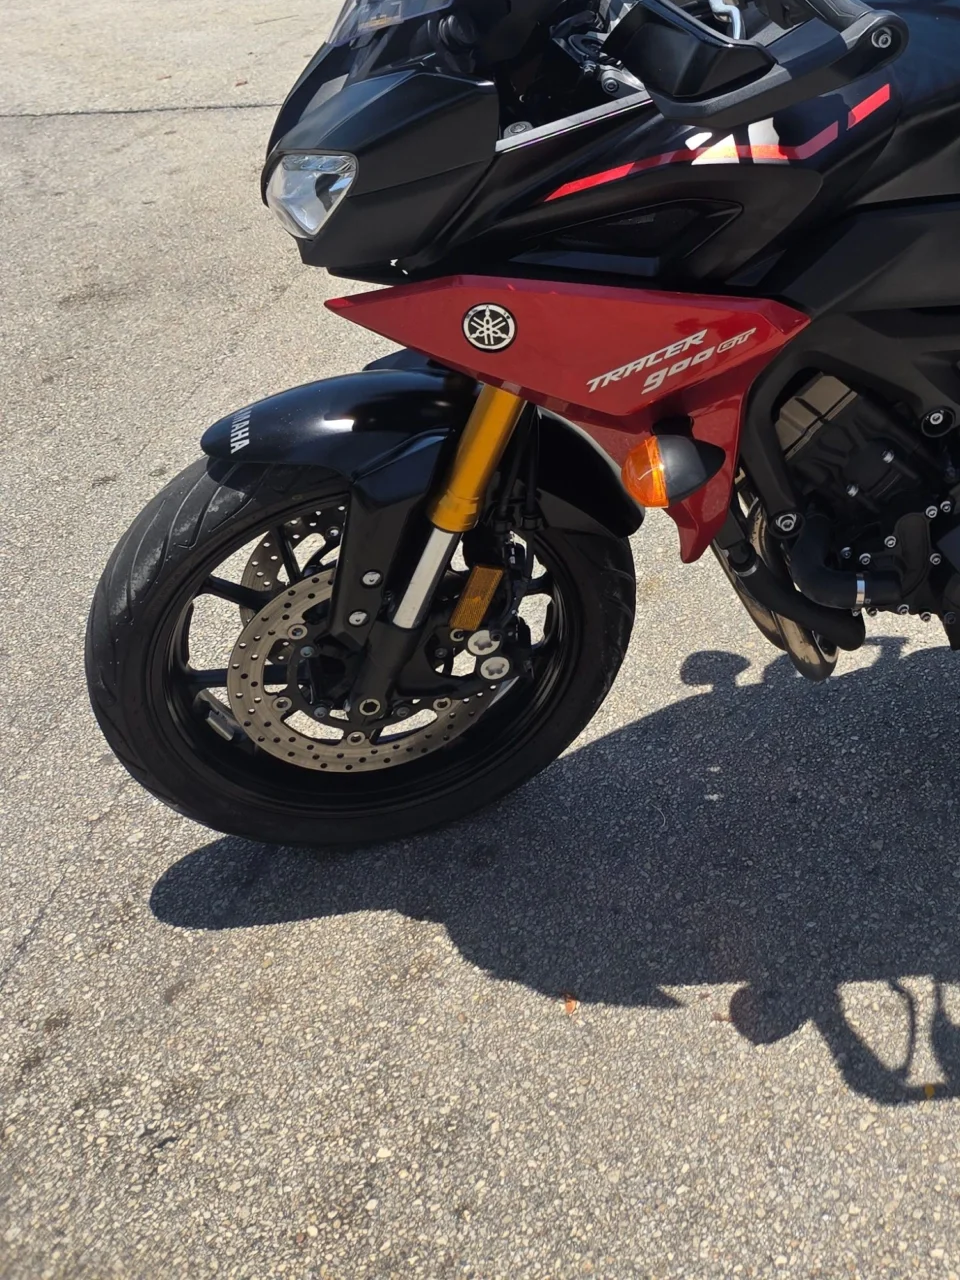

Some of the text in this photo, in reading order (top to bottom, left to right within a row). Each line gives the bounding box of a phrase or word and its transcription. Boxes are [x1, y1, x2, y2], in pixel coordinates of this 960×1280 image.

[586, 329, 708, 393] TRACER
[641, 327, 757, 395] 900 GT
